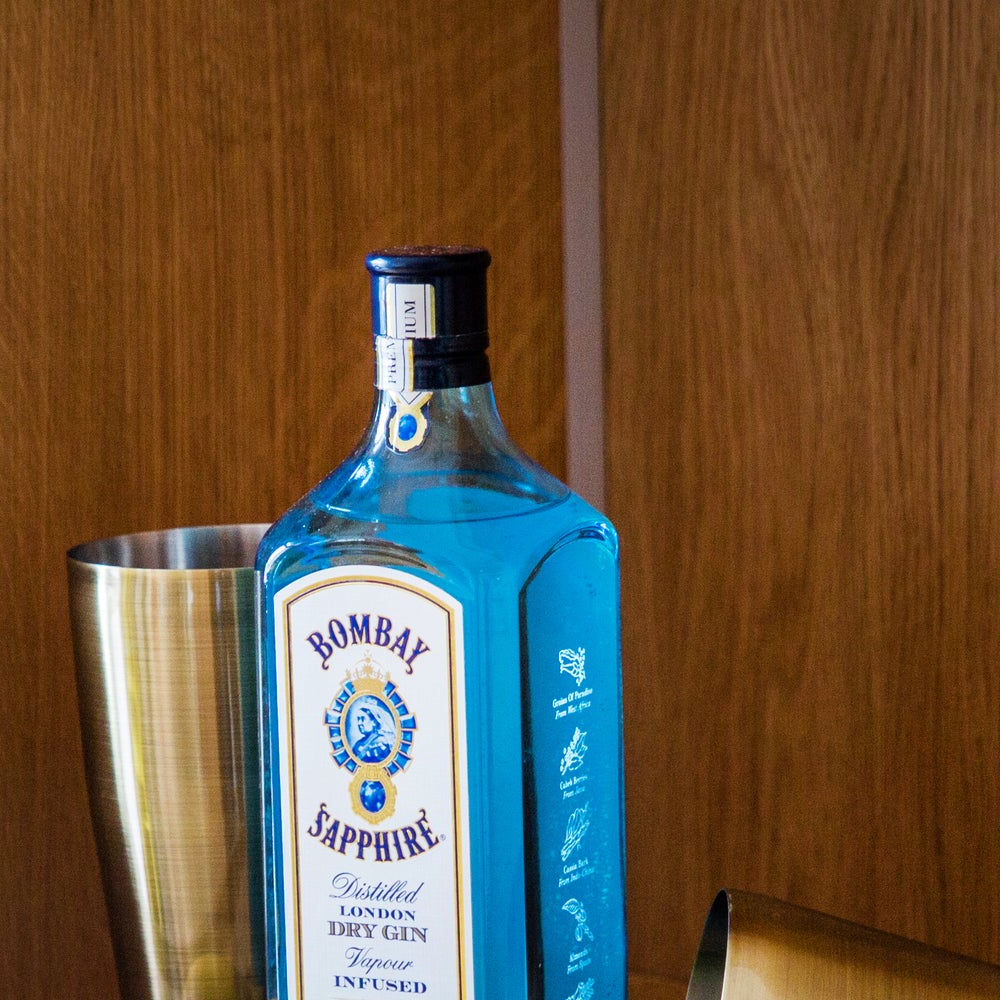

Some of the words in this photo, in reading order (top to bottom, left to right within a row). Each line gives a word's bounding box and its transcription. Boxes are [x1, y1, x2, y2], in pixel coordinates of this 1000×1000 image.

[306, 613, 431, 675] BOMBAY
[307, 802, 440, 863] SAPPHIRE
[328, 872, 425, 904] Distilled
[340, 905, 416, 921] LONDON
[327, 920, 378, 939] DRY
[381, 924, 428, 943] GIN
[344, 946, 414, 975] Vapour
[334, 975, 428, 994] INFUSED
